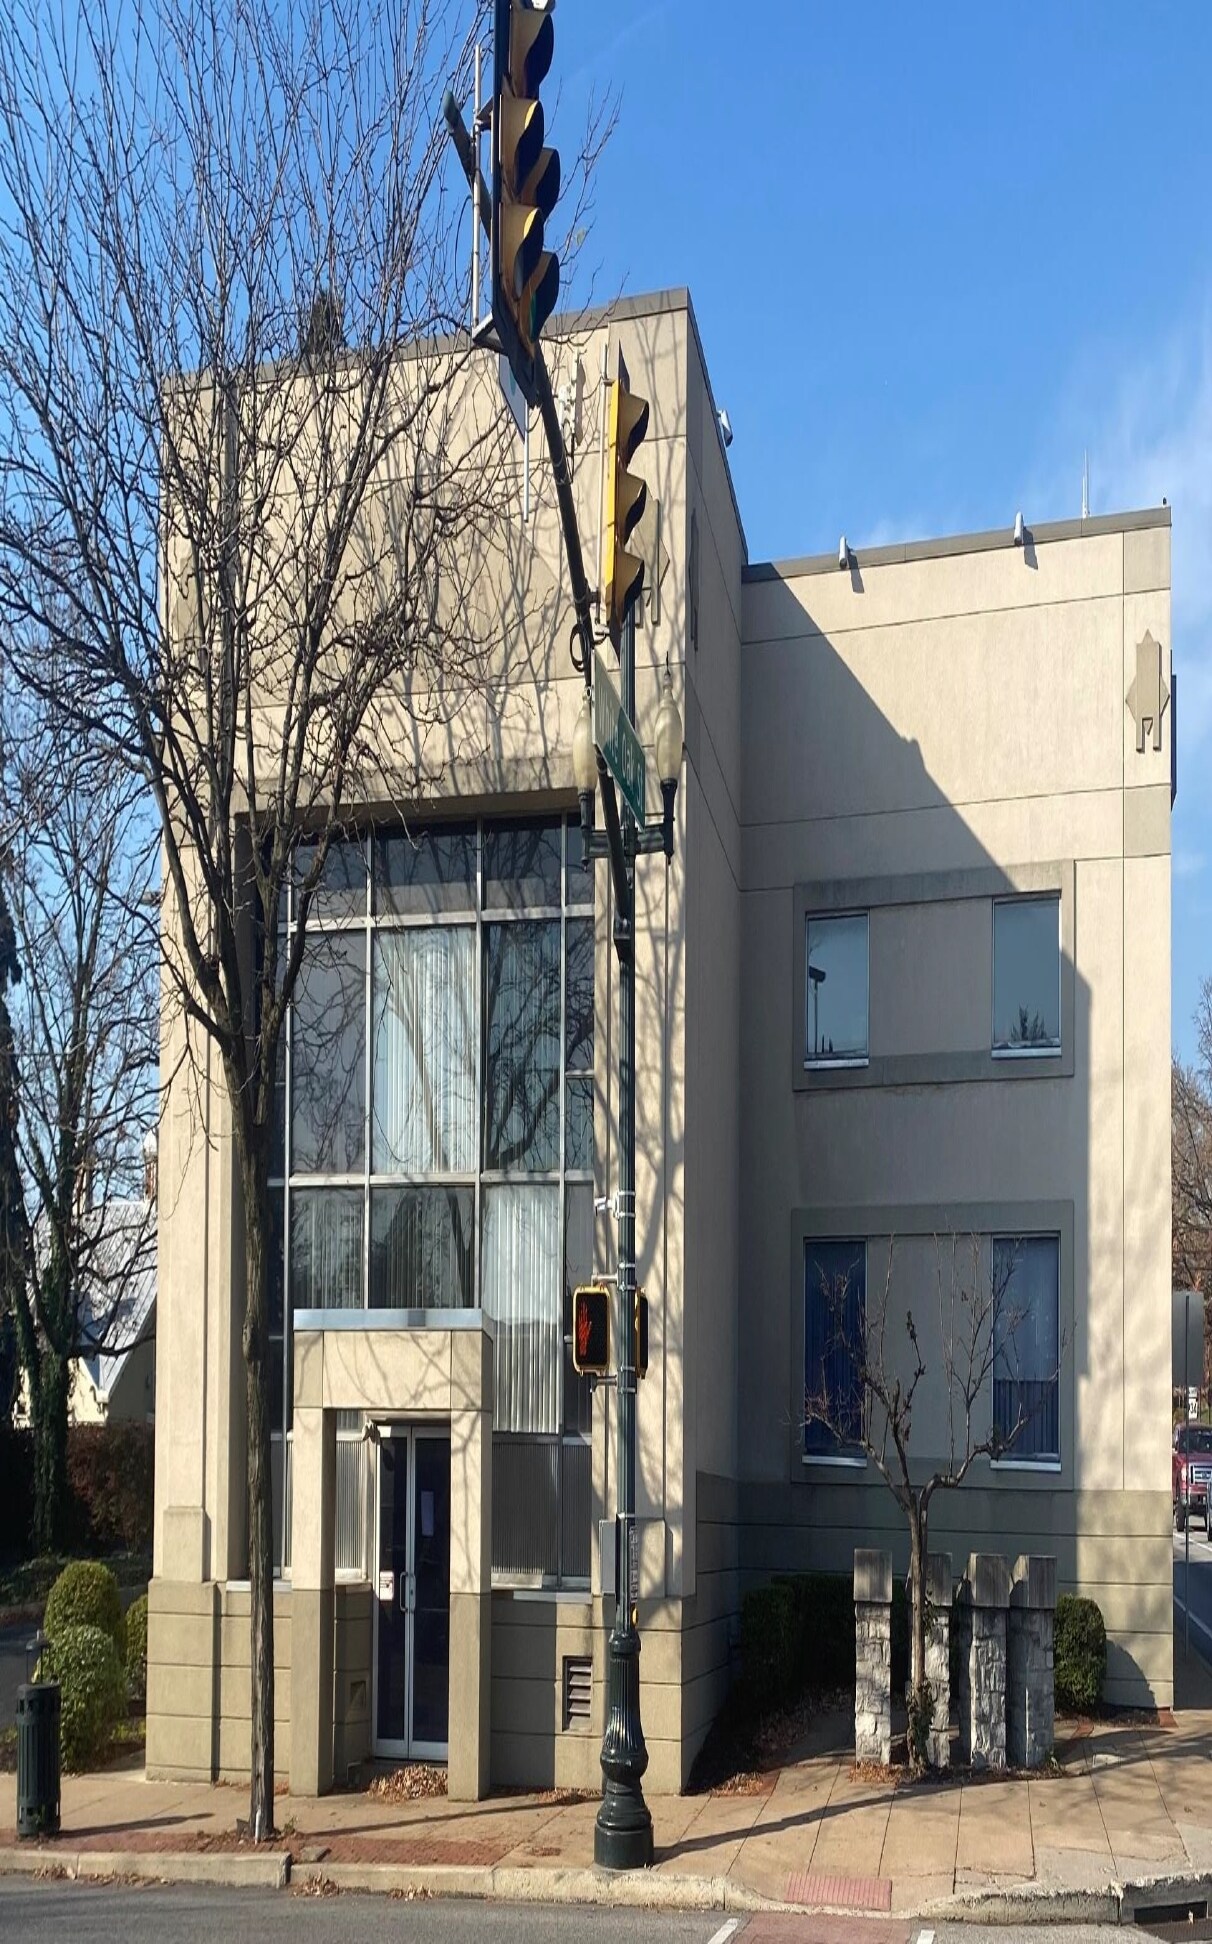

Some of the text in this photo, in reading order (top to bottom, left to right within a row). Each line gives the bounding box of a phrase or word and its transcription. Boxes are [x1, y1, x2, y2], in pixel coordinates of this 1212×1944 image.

[598, 682, 643, 812] White Oak St
